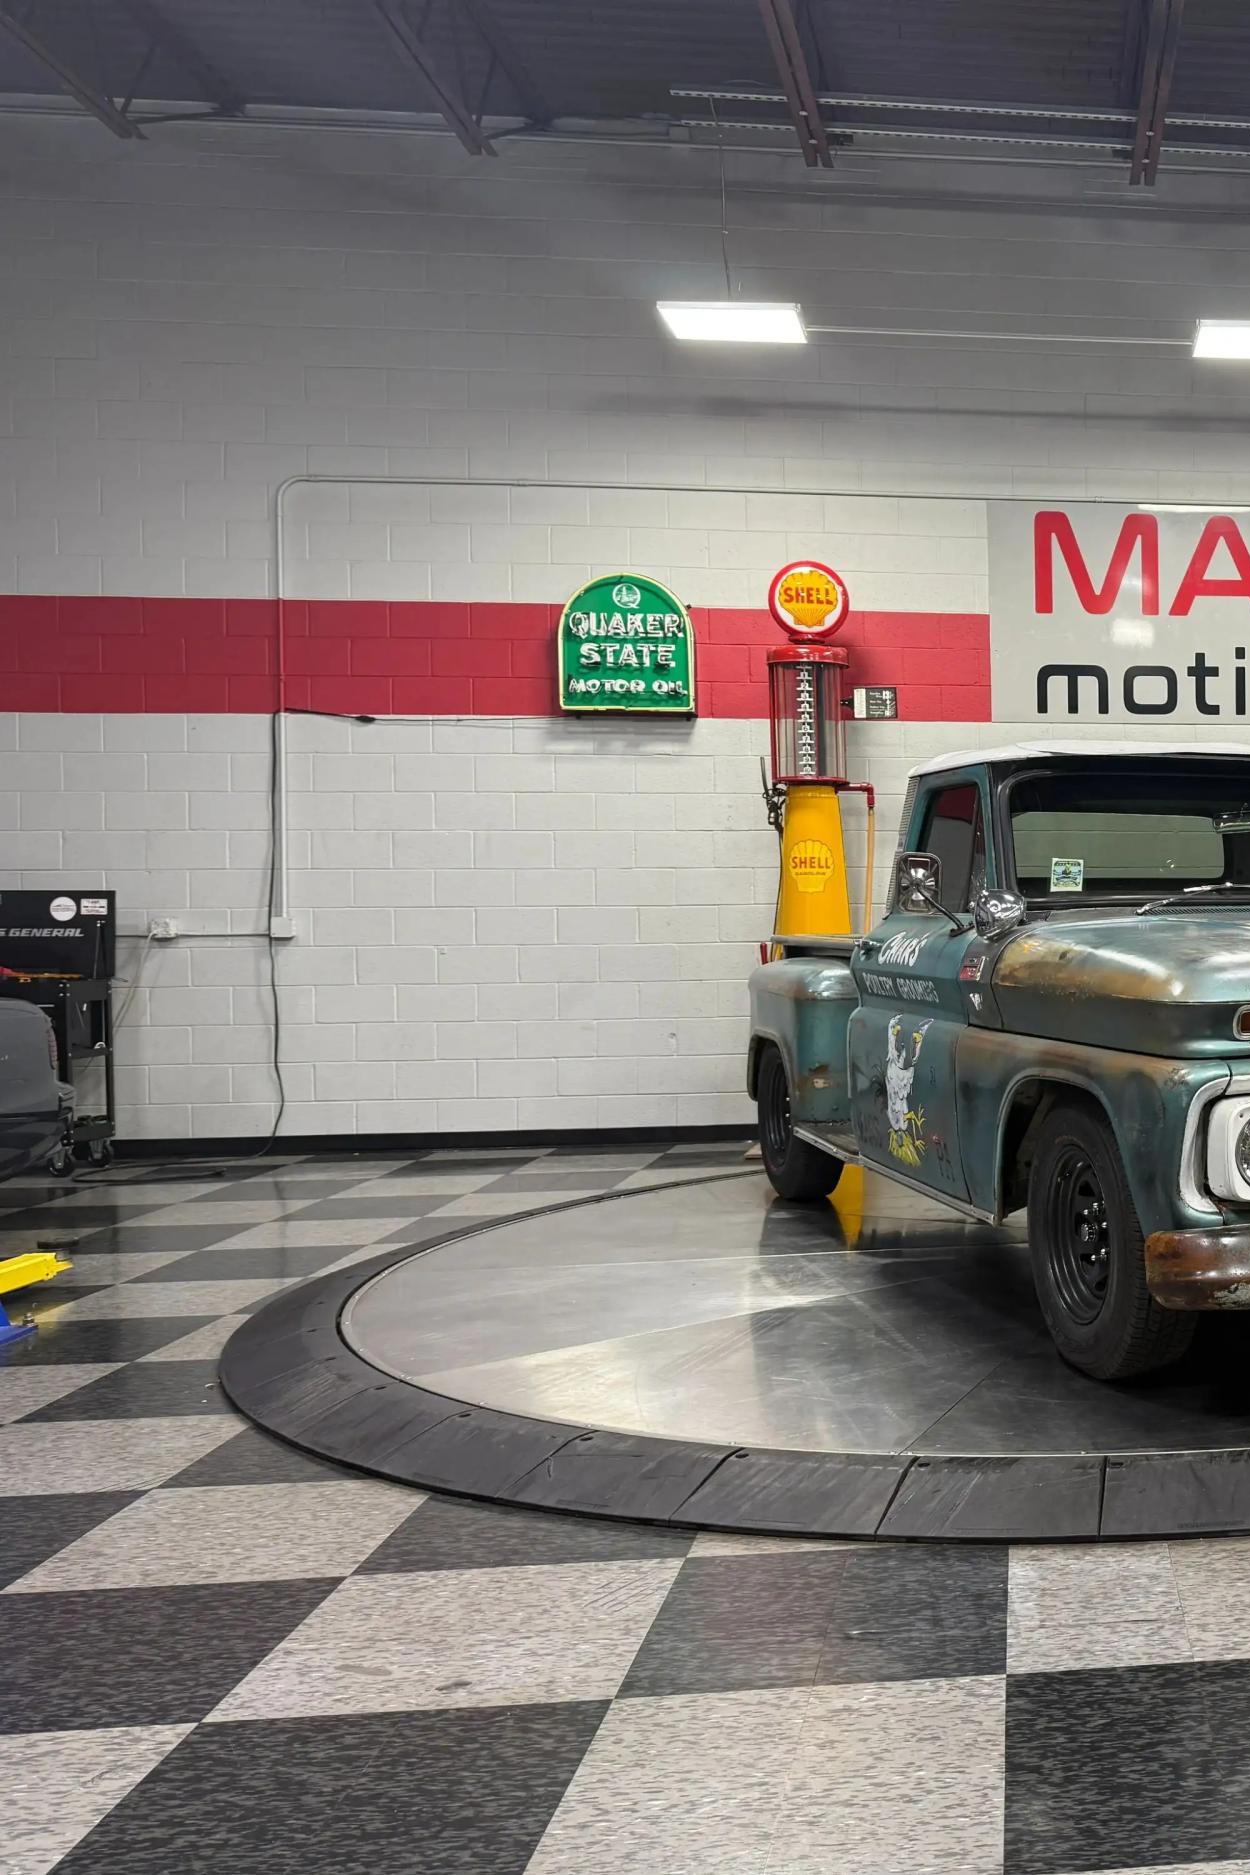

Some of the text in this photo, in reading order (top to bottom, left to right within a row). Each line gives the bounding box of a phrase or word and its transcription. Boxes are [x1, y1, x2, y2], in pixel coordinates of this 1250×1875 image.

[782, 586, 834, 606] SHELL
[569, 611, 685, 639] QUAKER
[580, 642, 677, 668] STATE
[569, 678, 688, 696] MOTOR OIL
[791, 856, 831, 869] SHELL
[8, 927, 85, 937] GENERAL
